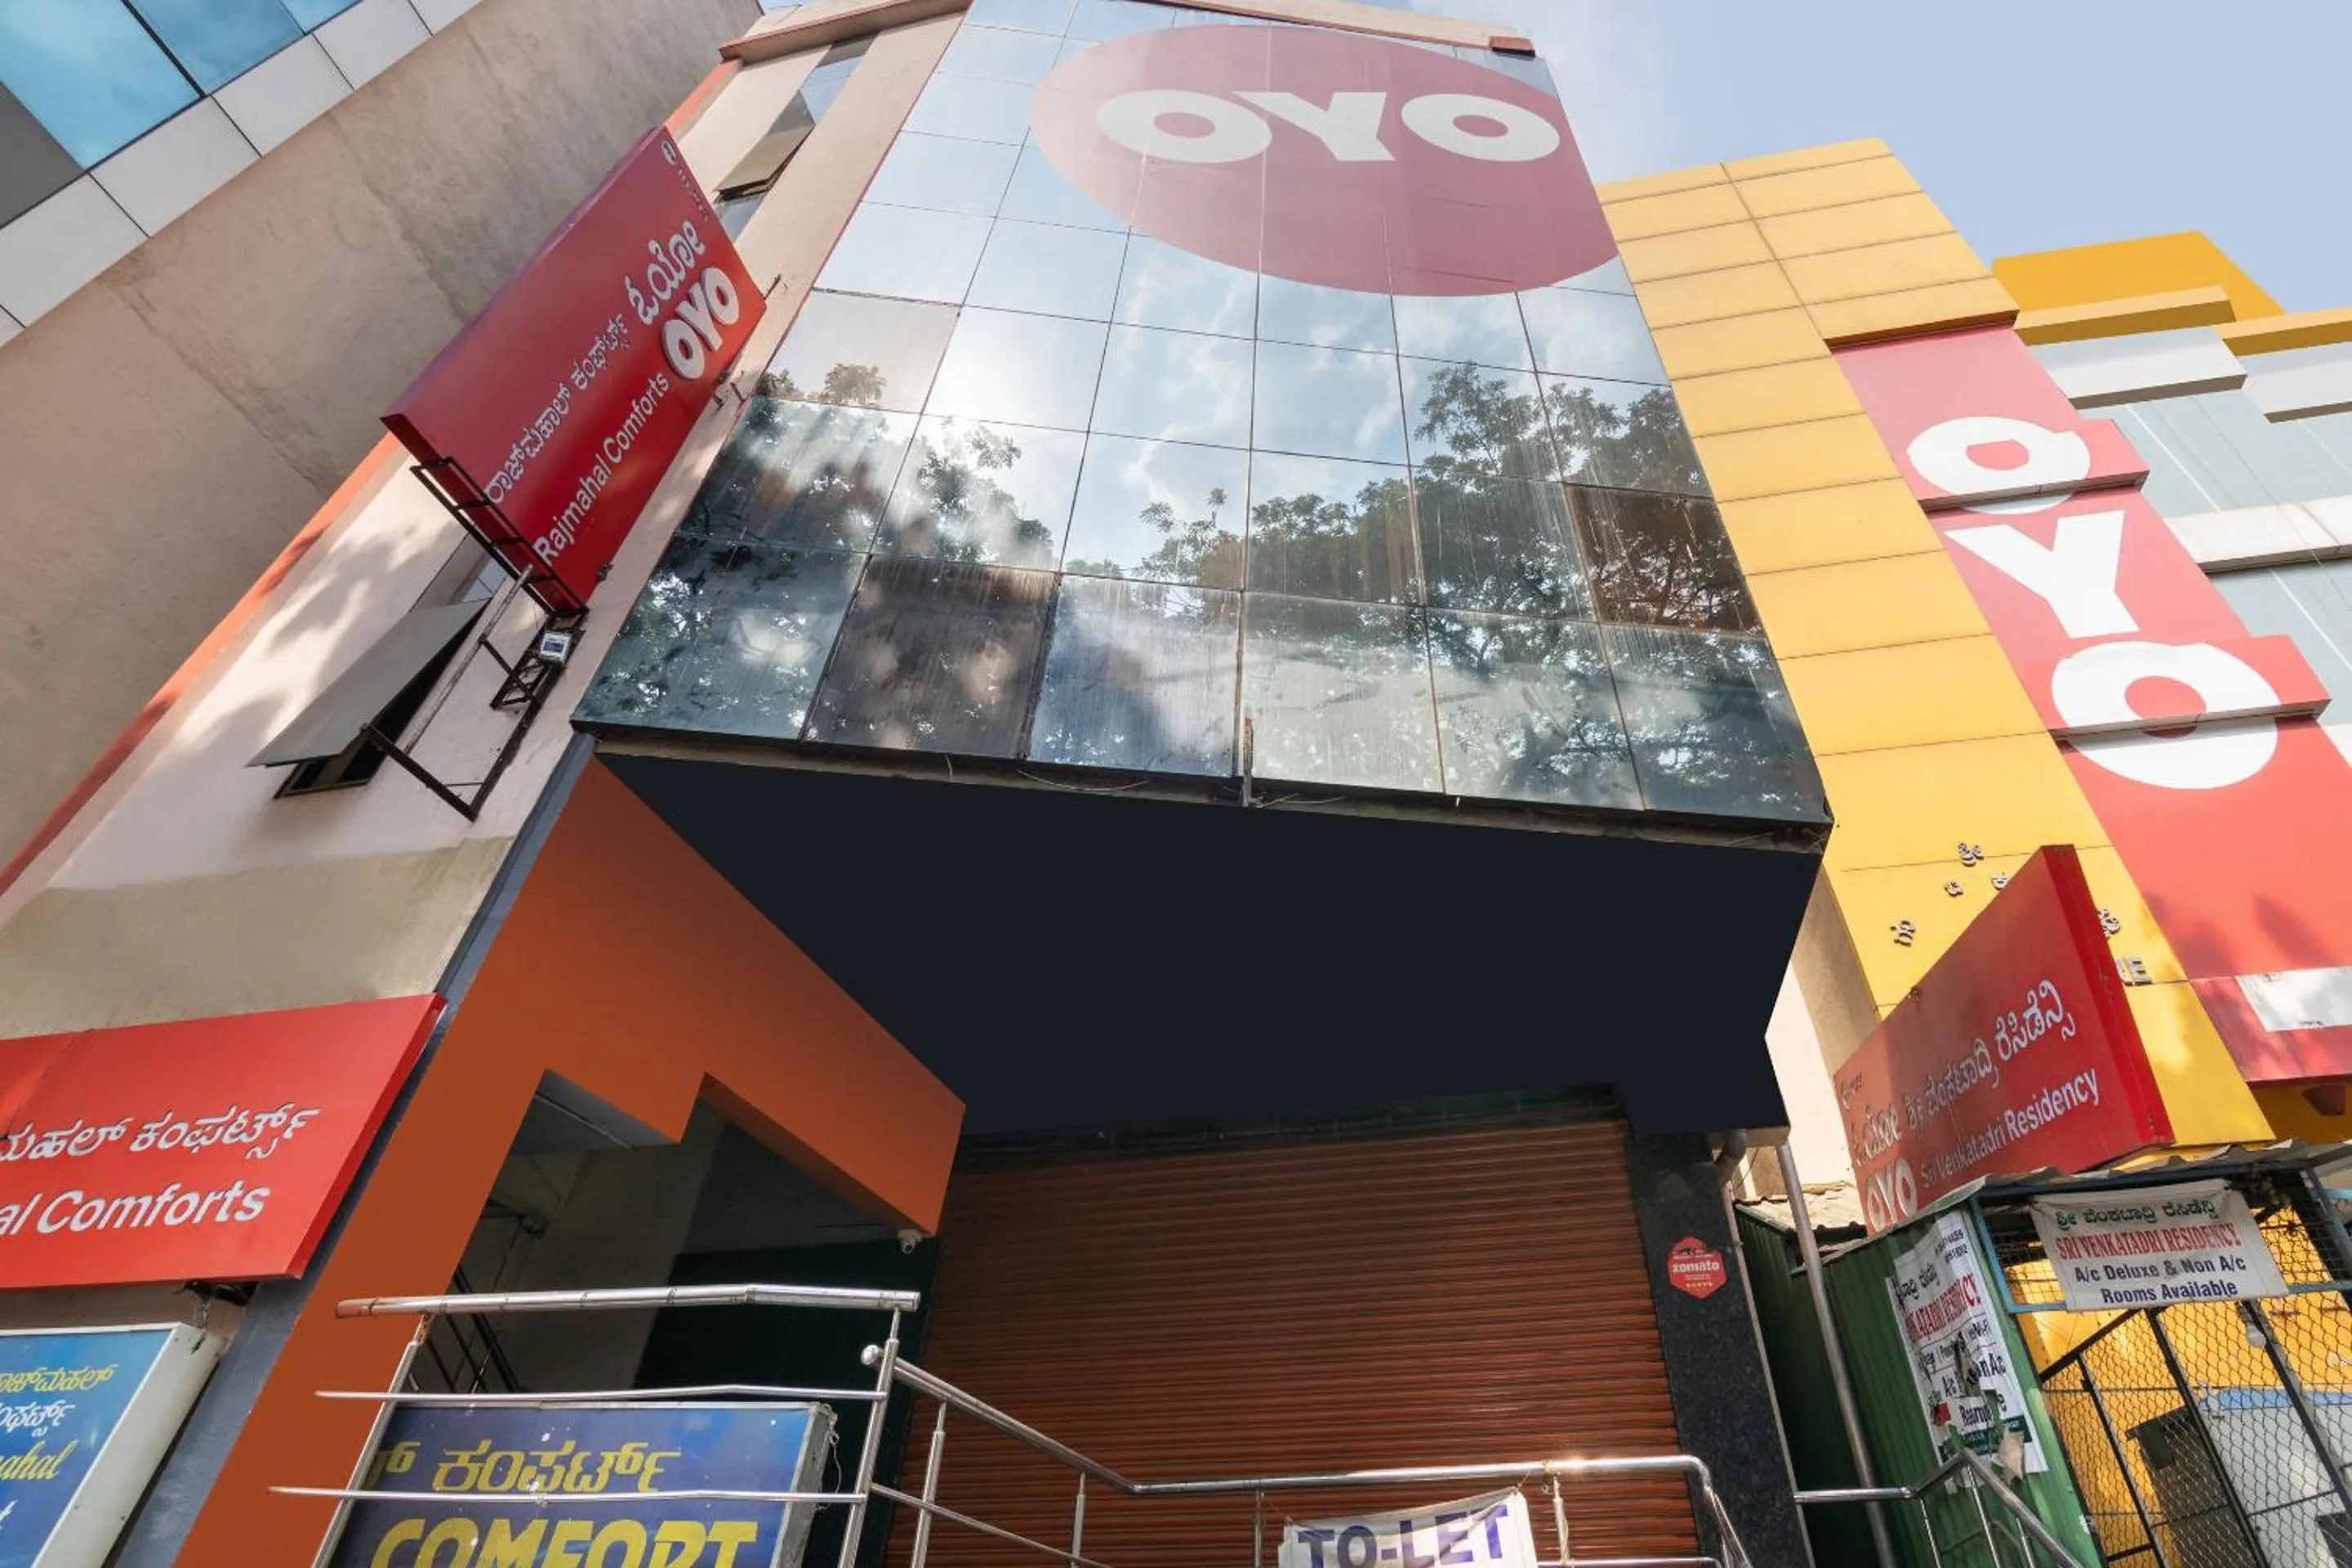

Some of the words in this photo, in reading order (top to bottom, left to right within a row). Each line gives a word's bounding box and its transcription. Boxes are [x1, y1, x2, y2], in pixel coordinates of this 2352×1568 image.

[1094, 89, 1561, 163] OYO
[663, 267, 739, 380] OYO
[533, 453, 612, 566] Rajmahal
[603, 372, 670, 464] Comforts
[1907, 416, 2282, 790] OYO
[1921, 1160, 1936, 1187] Sri
[1937, 1116, 2007, 1179] Venkatadri
[2004, 1067, 2100, 1143] Residency
[37, 1180, 271, 1235] Comforts
[1866, 1156, 1918, 1232] OYO
[1673, 1260, 1720, 1273] zomato
[2055, 1235, 2082, 1260] SRI
[2082, 1226, 2164, 1258] VENKATADRI
[2165, 1222, 2242, 1256] RESIDENCY
[2075, 1267, 2100, 1283] A/c
[2103, 1263, 2160, 1281] Deluxe
[2163, 1259, 2180, 1276] &
[2181, 1258, 2216, 1274] Non
[2219, 1254, 2247, 1272] A/c
[2100, 1286, 2158, 1304] Rooms
[2162, 1279, 2238, 1300] Available
[369, 1517, 759, 1568] COMFORT
[1298, 1503, 1508, 1568] TO-LET
